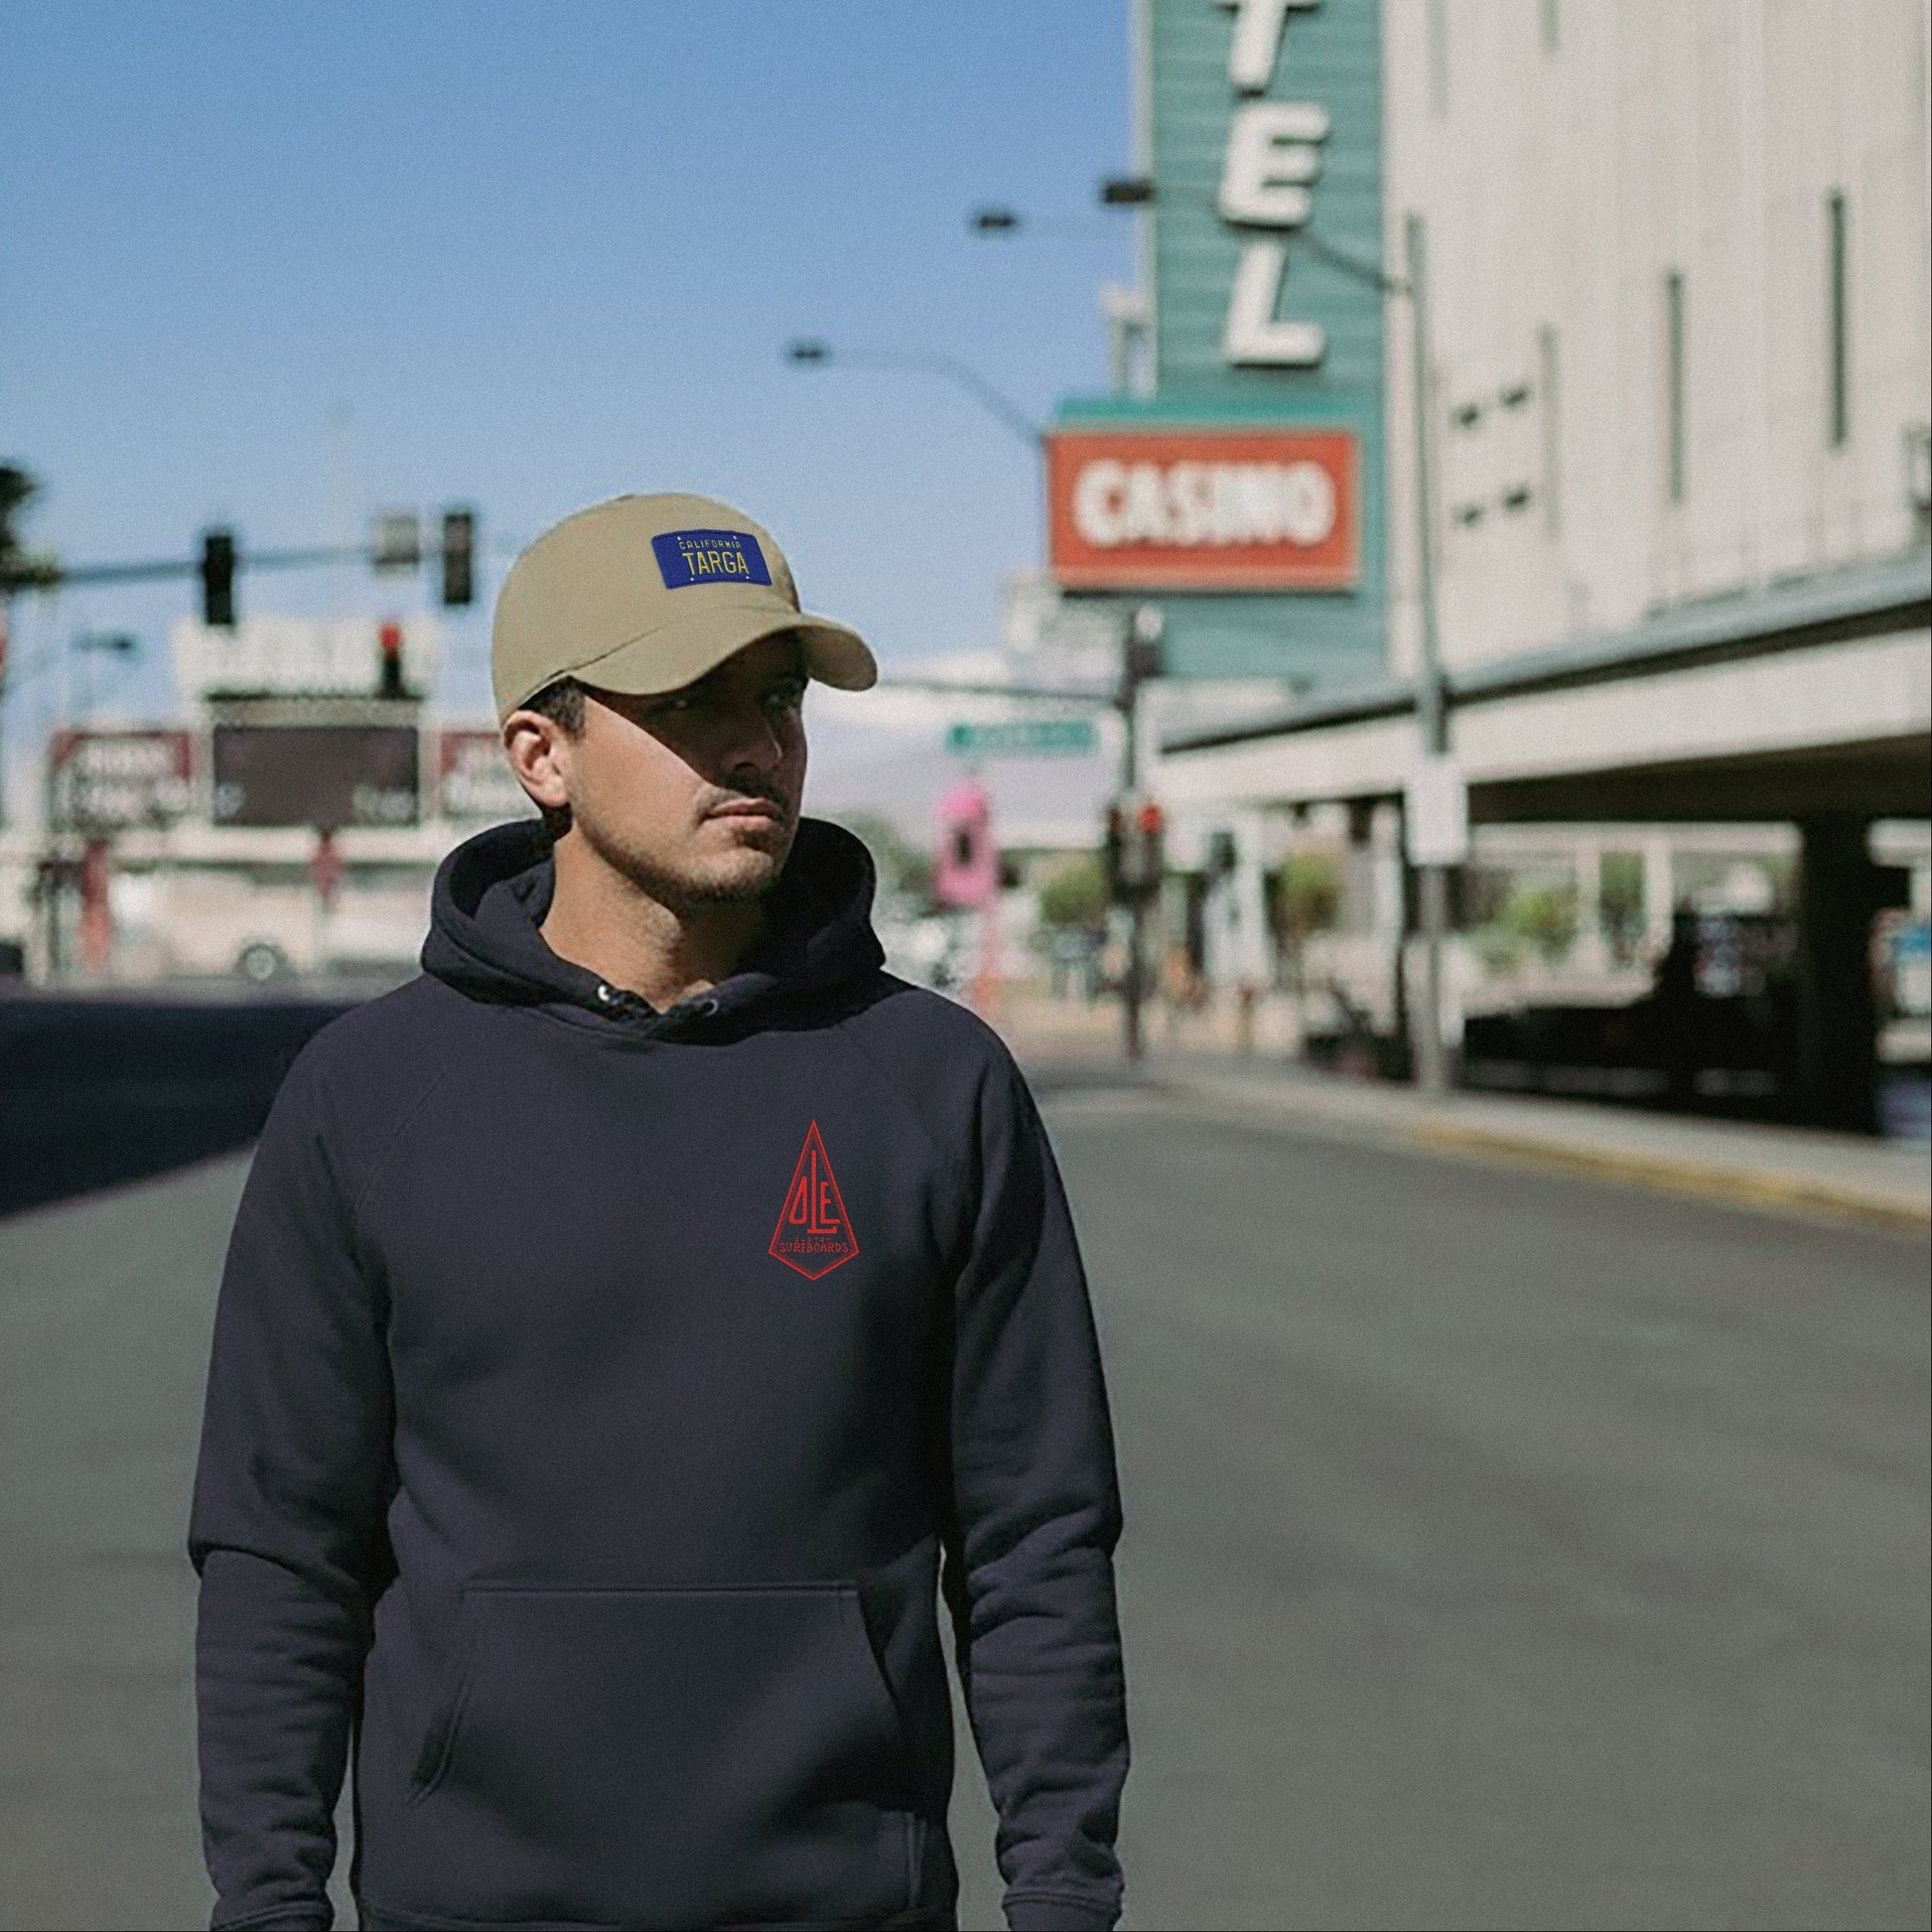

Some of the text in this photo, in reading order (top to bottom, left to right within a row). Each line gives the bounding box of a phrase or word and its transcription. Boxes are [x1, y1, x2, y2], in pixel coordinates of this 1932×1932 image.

[1215, 0, 1330, 364] TEL
[1074, 459, 1337, 546] CASINO
[679, 540, 741, 550] CALIFORNIA
[682, 551, 750, 575] TARGA
[788, 1150, 841, 1234] OLE
[778, 1242, 849, 1253] SURFBOARDS
